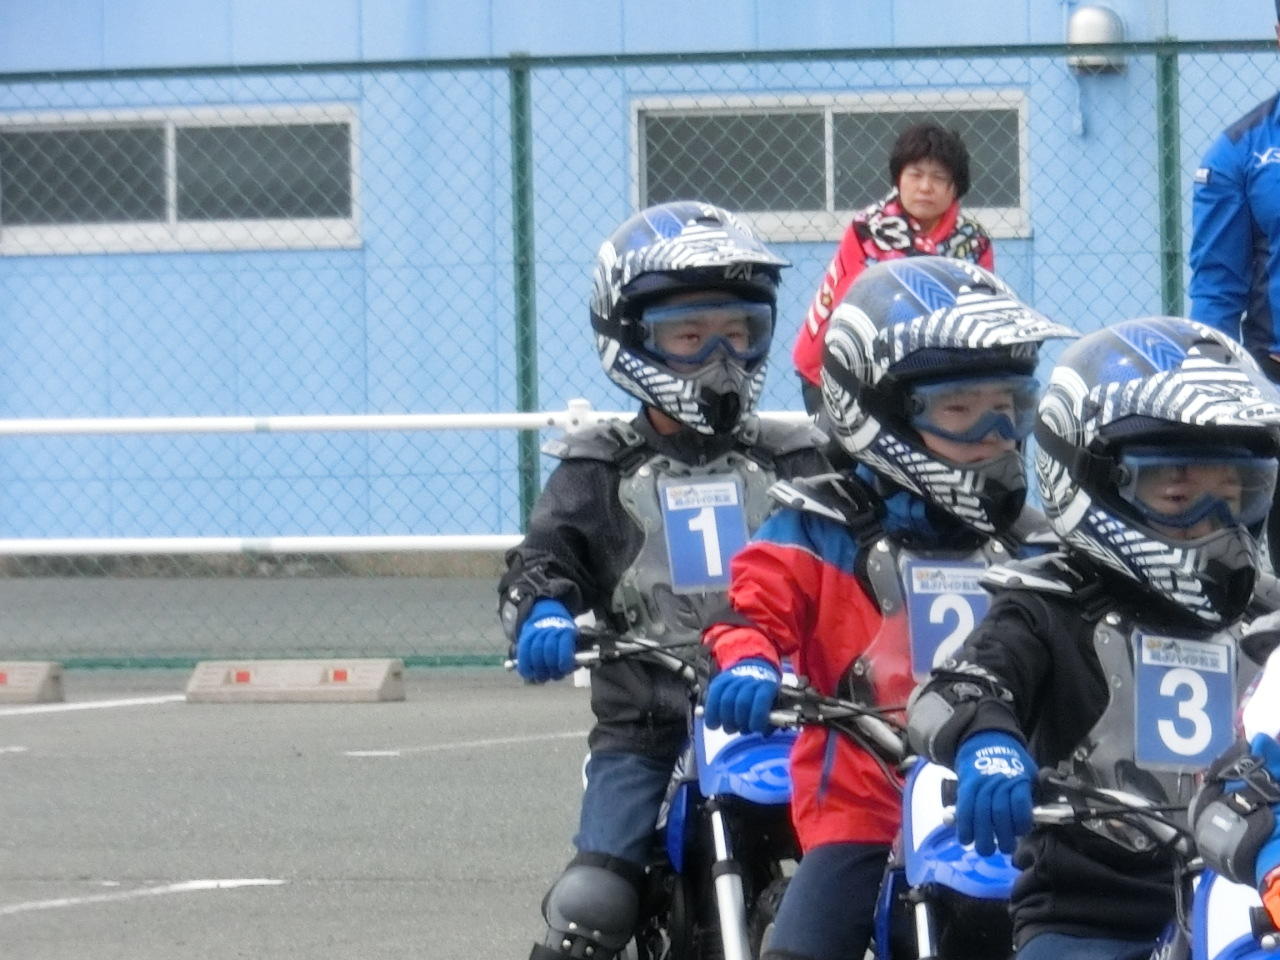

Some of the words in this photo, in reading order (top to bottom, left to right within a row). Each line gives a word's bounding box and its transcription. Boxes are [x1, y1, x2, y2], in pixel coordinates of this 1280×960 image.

[688, 506, 723, 577] 1
[929, 593, 975, 672] 2
[1157, 667, 1213, 757] 3
